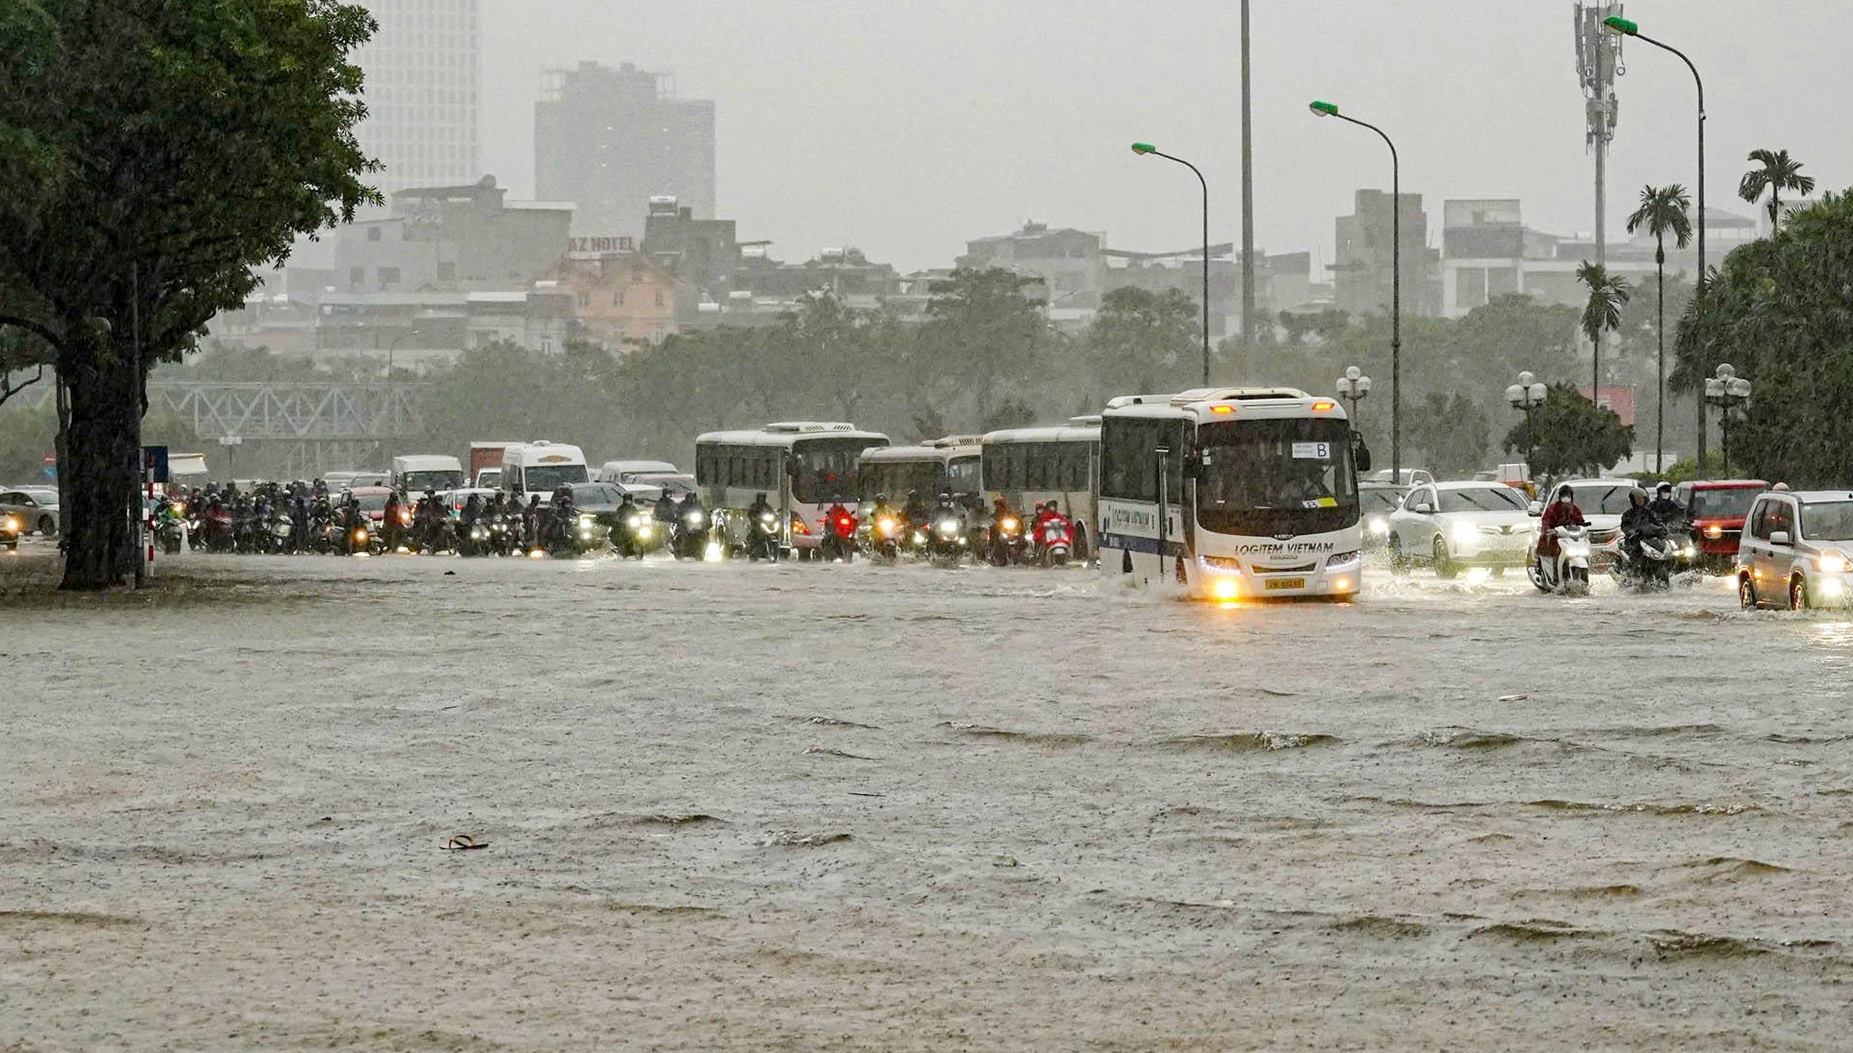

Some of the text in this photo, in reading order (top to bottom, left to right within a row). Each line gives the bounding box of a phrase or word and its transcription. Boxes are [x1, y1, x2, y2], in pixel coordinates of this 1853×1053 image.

[568, 236, 633, 252] AZ HOTEL
[1317, 443, 1327, 457] B
[1235, 542, 1334, 555] LOGITEM VIETNAM
